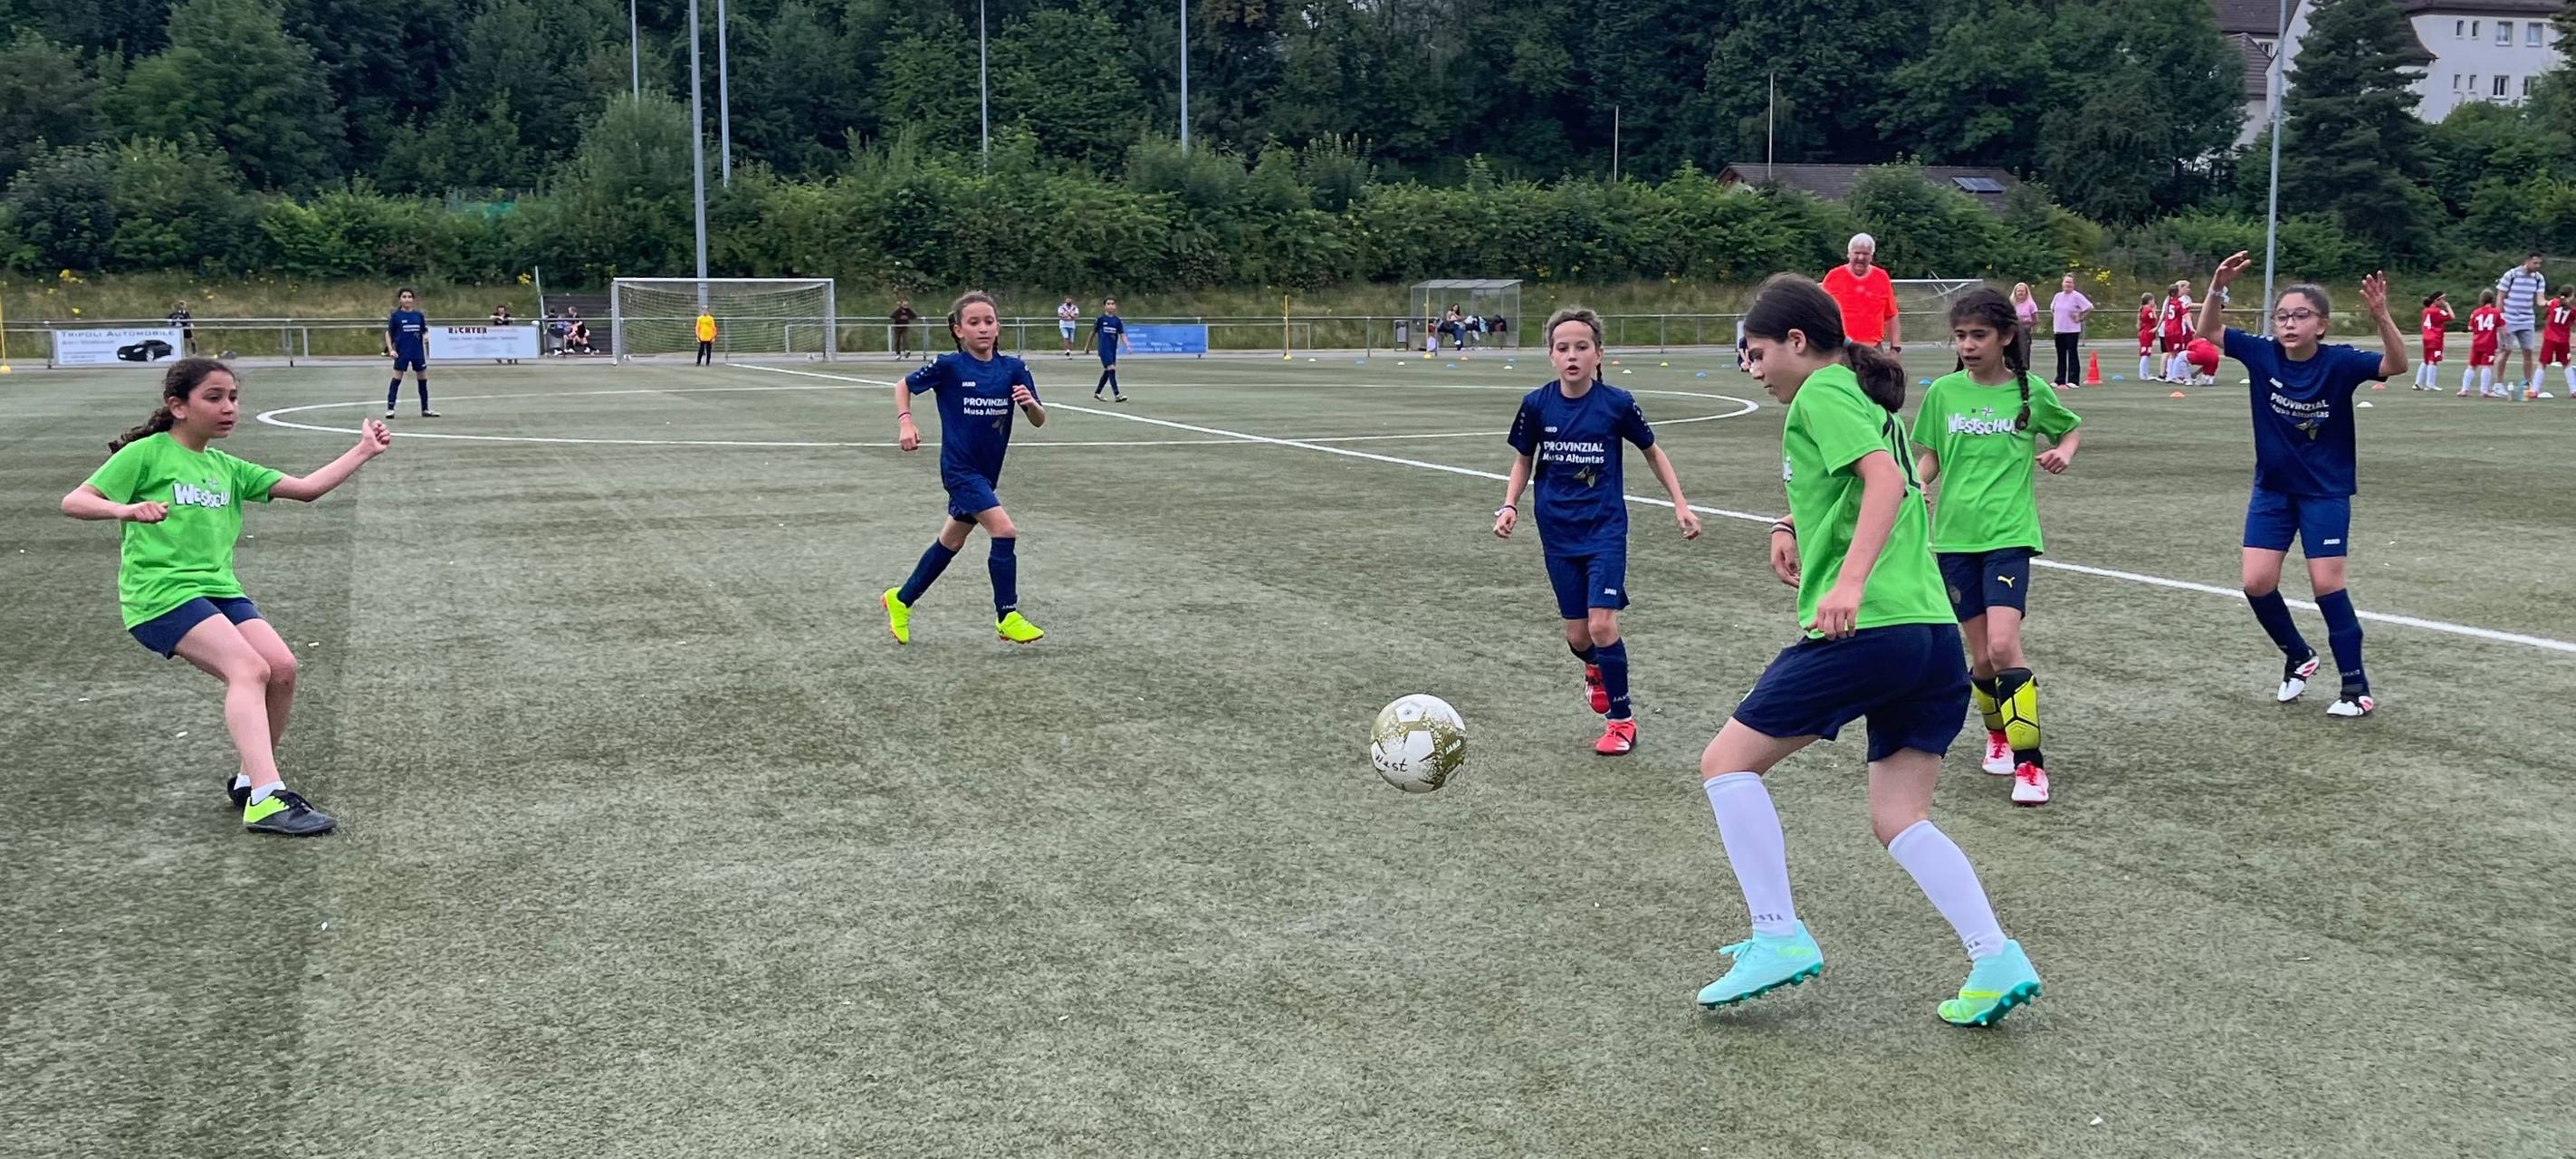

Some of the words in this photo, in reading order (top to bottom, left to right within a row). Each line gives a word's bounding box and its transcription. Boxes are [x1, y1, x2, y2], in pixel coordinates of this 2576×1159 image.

[2168, 304, 2176, 320] 5
[2423, 313, 2432, 330] 4
[2475, 313, 2495, 330] 14
[963, 398, 1009, 407] PROVINZIAL
[963, 407, 984, 416] Musa
[1543, 441, 1604, 453] PROVINZIAL
[1542, 453, 1565, 462] Musa
[1566, 454, 1604, 464] Altuntas
[1445, 739, 1461, 755] JAKO
